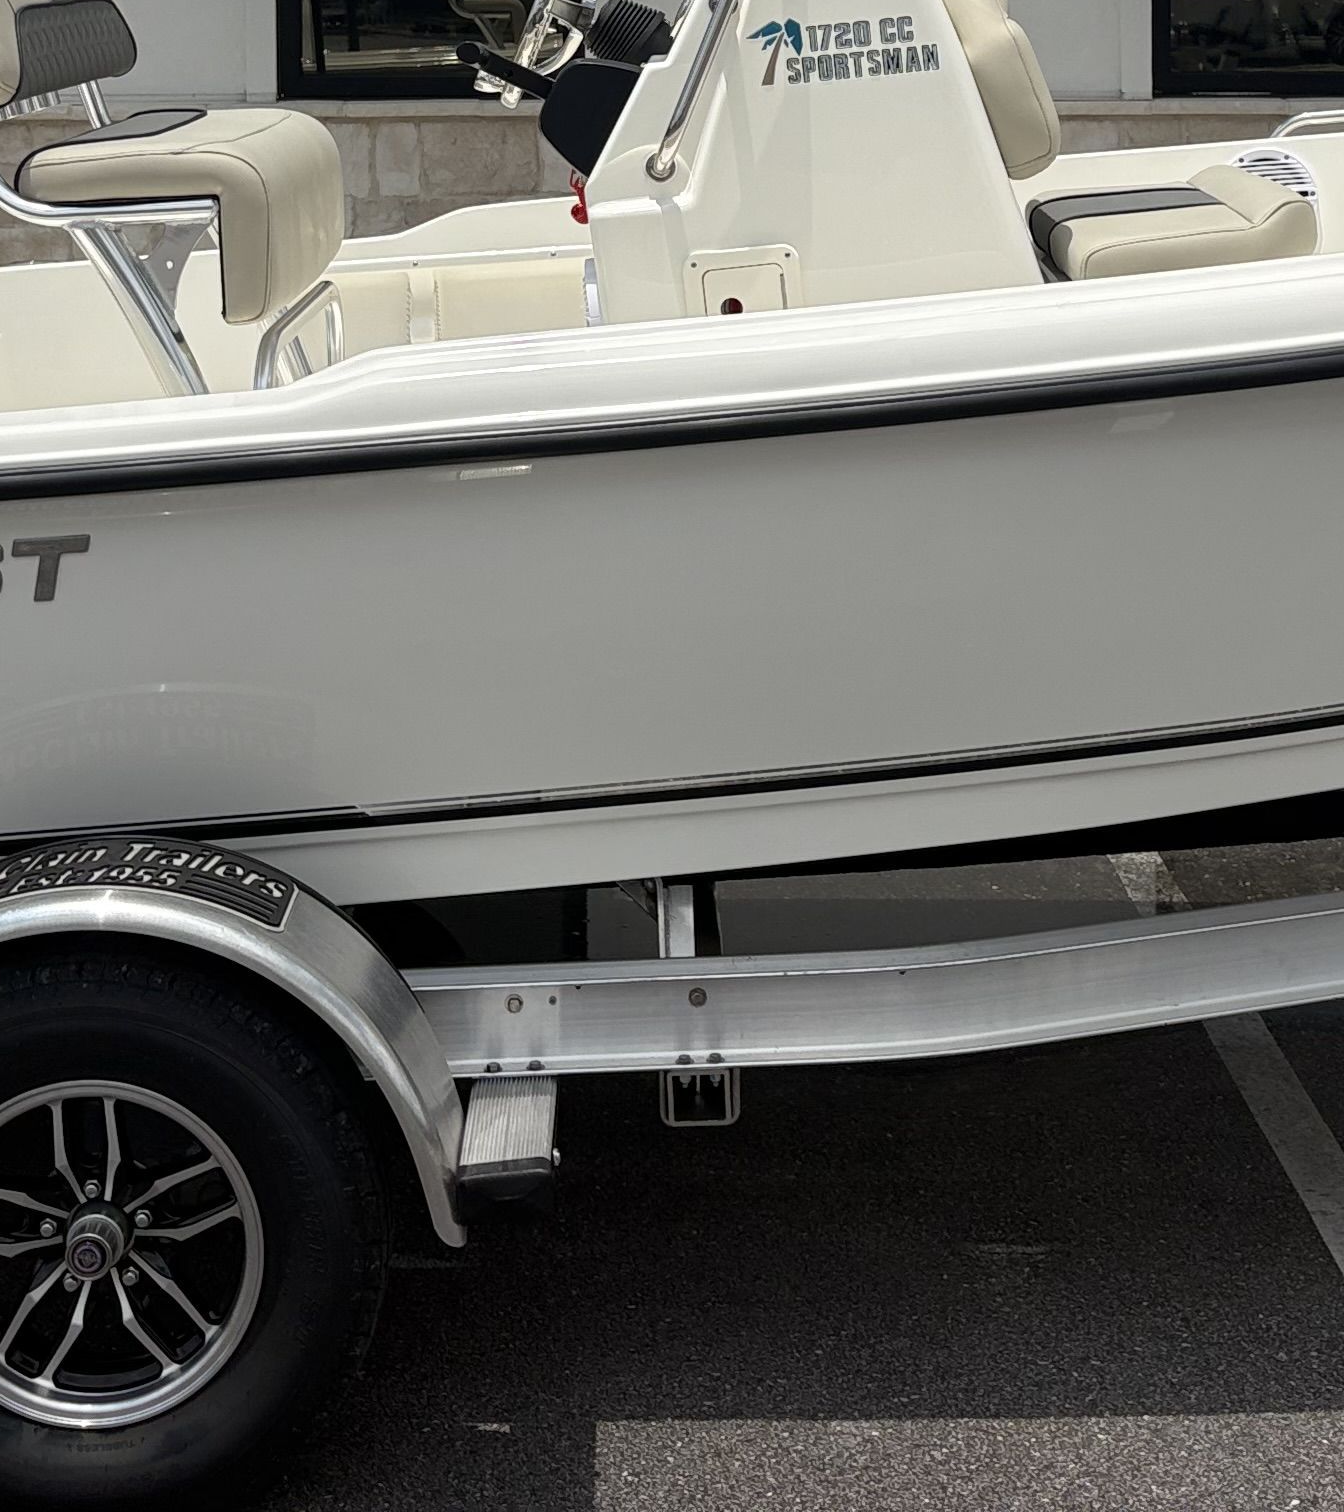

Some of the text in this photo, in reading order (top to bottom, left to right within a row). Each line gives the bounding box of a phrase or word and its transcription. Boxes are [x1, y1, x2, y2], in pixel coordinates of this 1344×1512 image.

[805, 15, 915, 53] 1720 CC
[786, 43, 940, 85] SPORTSMAN
[87, 864, 183, 887] 1955
[119, 842, 289, 899] Trailers
